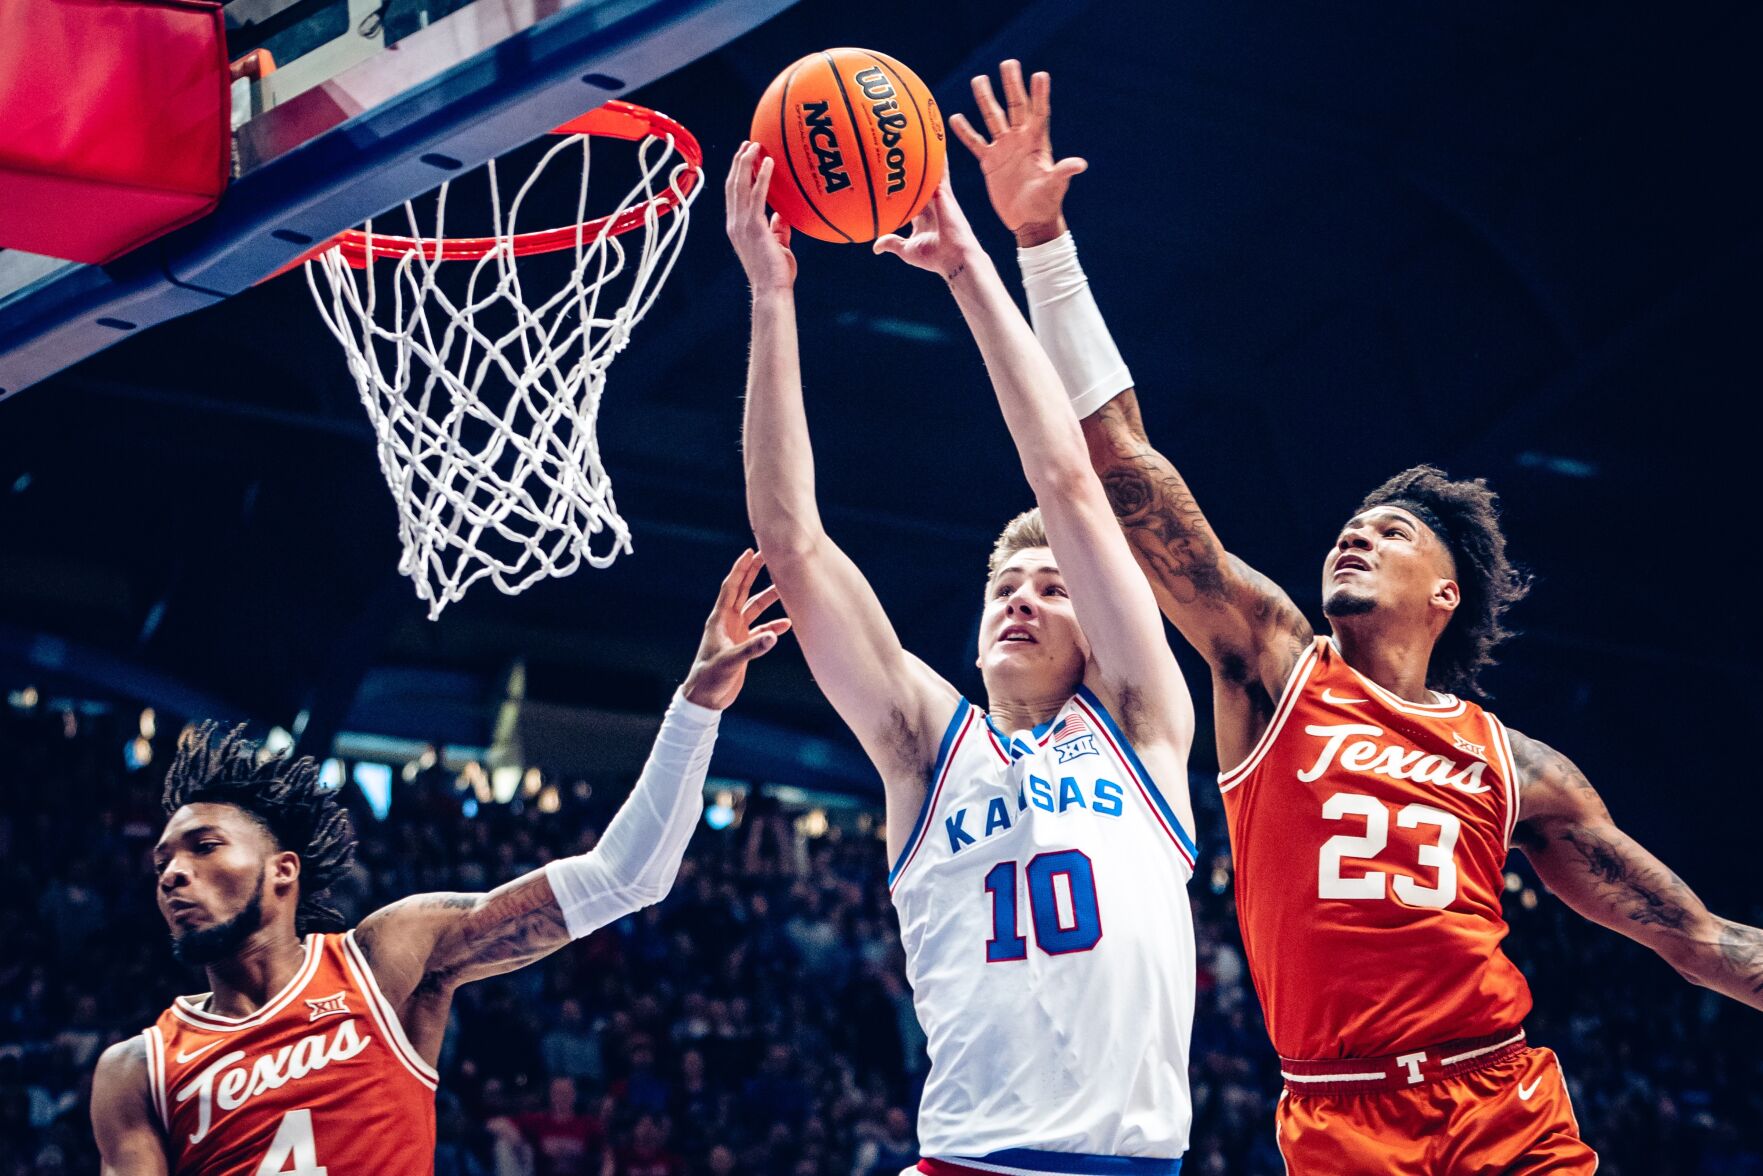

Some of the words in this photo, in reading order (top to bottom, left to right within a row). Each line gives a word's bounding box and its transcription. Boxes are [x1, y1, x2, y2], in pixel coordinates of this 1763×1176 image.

[802, 100, 852, 194] NCAA
[855, 66, 908, 196] Wilson
[1297, 724, 1492, 794] Texas
[1318, 792, 1461, 910] 23
[985, 849, 1103, 963] 10
[176, 1019, 371, 1144] Texas
[1397, 1051, 1427, 1084] T
[255, 1108, 328, 1176] 4
